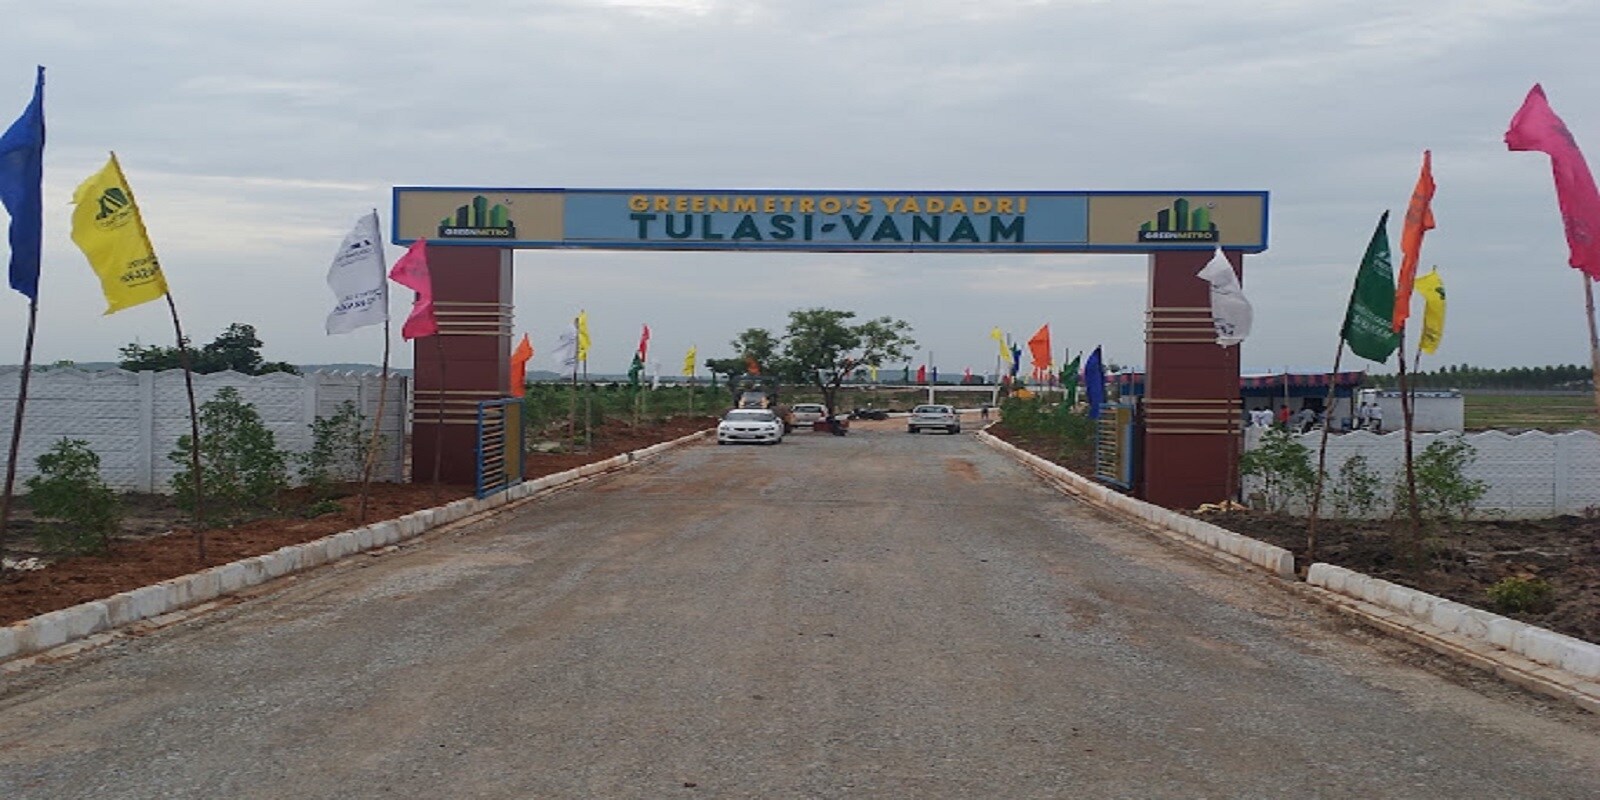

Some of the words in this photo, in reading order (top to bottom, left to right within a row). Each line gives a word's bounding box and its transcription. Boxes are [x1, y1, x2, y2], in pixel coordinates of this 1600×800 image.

[630, 196, 873, 213] GREENMETRO'S
[882, 197, 1027, 213] YADADRI
[444, 228, 510, 237] GREENMETRO
[630, 214, 1025, 243] TULASI-VANAM
[1143, 231, 1213, 240] GREENMETRO
